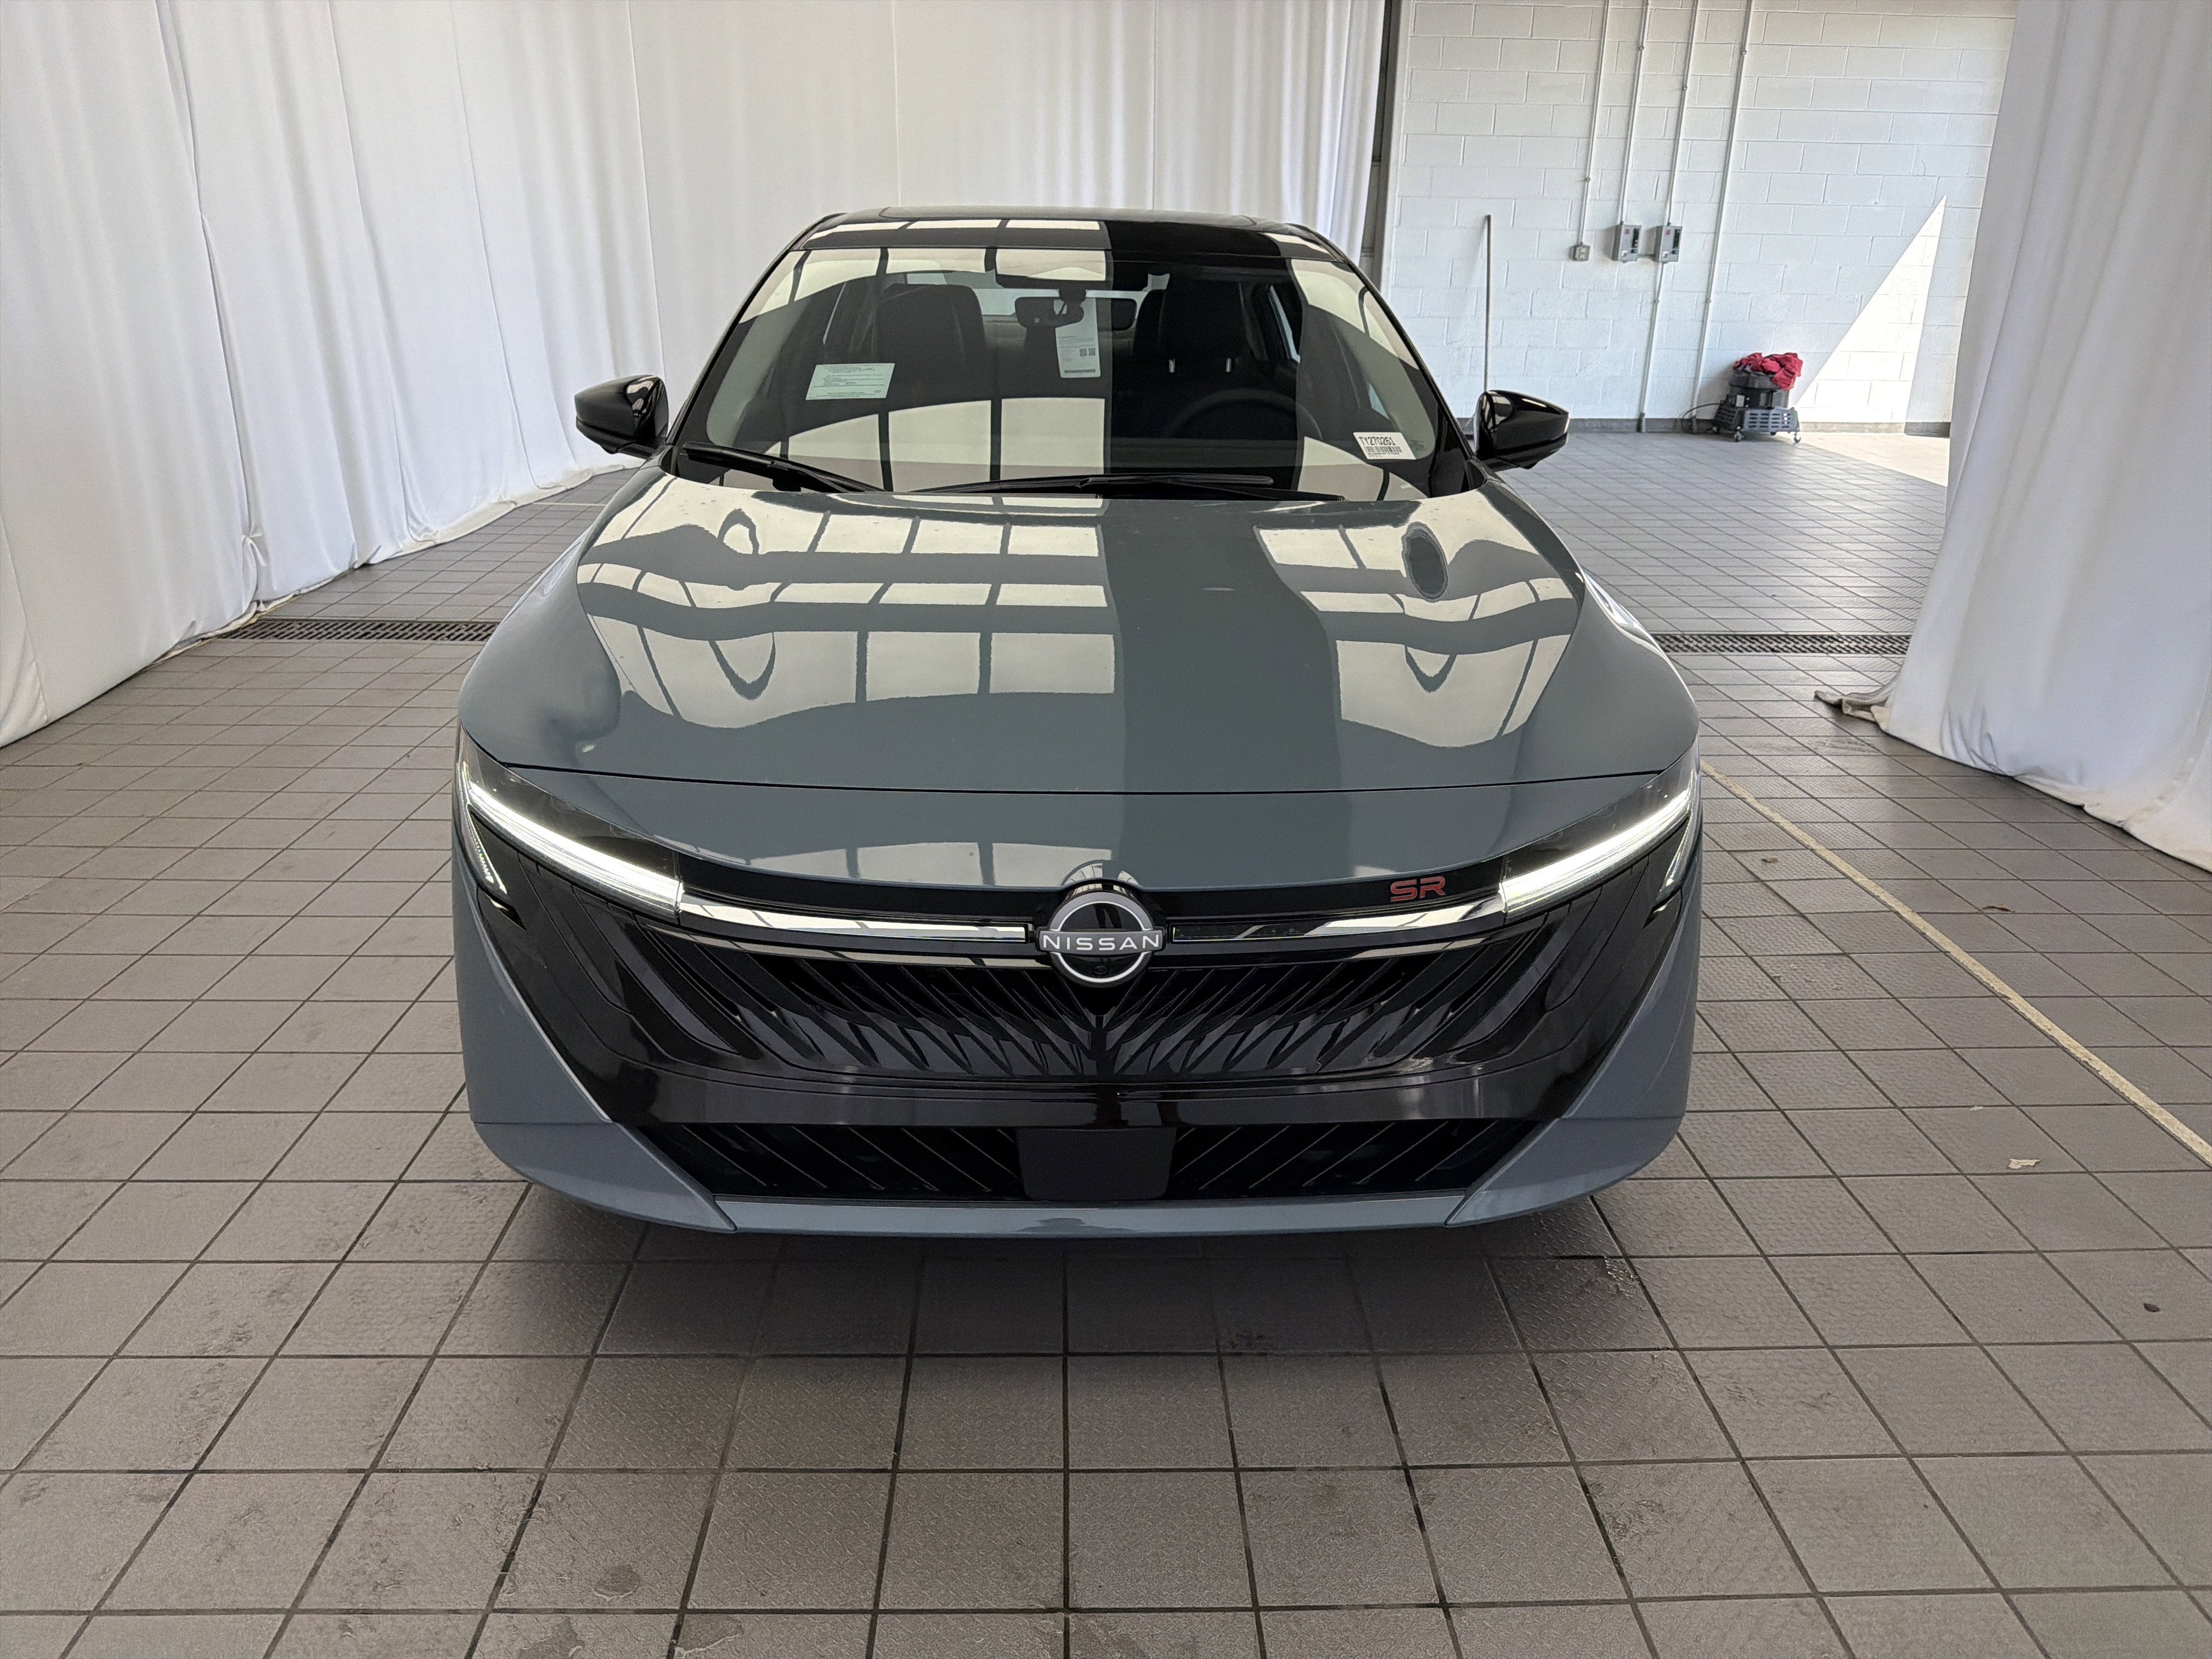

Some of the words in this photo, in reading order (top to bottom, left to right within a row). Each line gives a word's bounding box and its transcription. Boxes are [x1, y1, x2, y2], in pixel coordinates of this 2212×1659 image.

[1358, 436, 1396, 445] TY270261
[1390, 876, 1446, 902] SR
[1043, 934, 1159, 951] NISSAN
